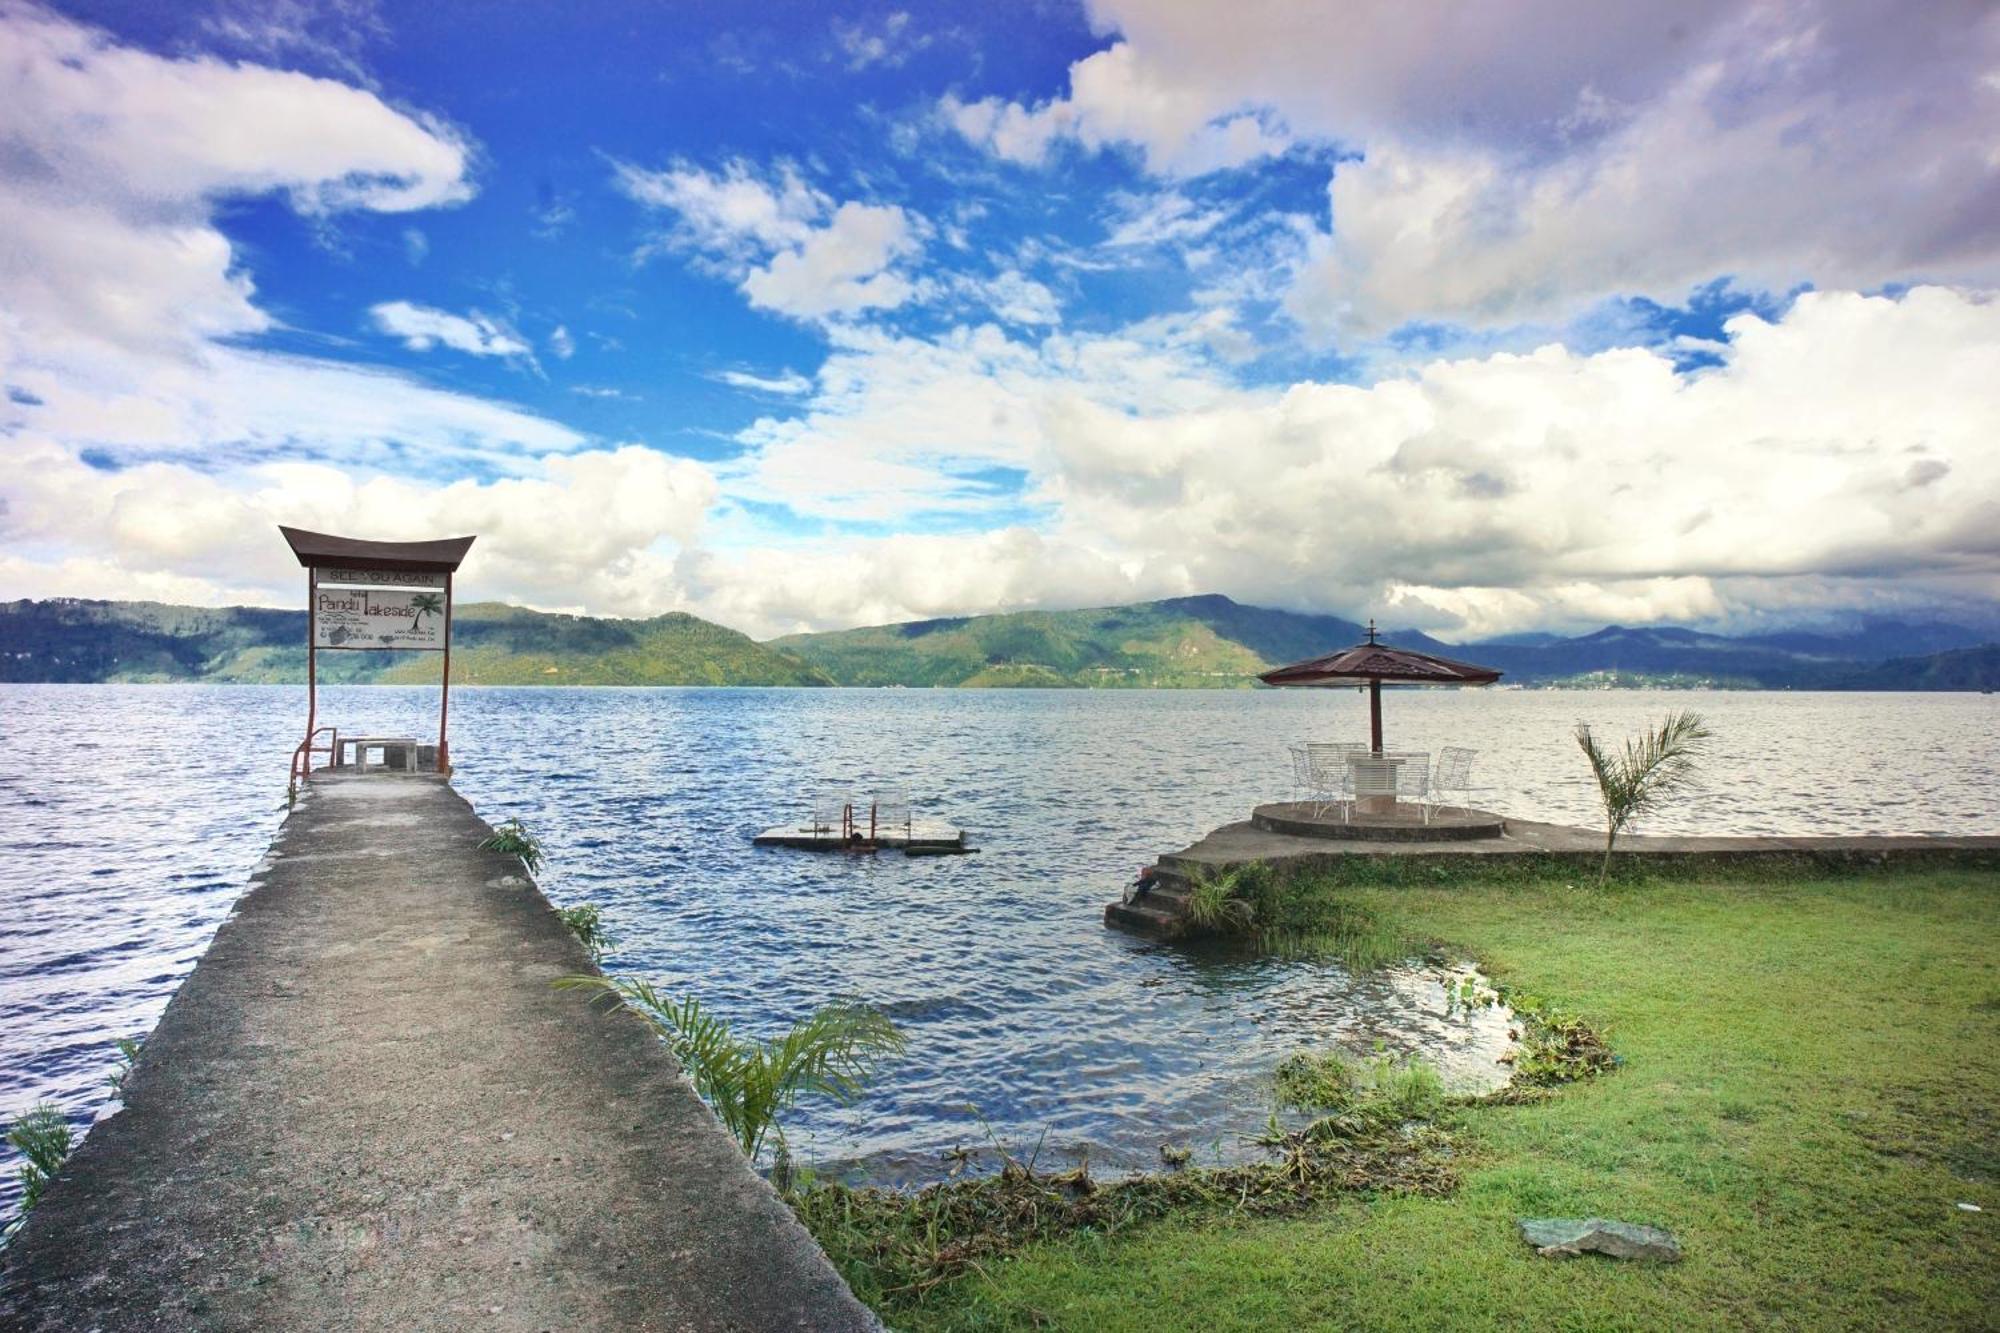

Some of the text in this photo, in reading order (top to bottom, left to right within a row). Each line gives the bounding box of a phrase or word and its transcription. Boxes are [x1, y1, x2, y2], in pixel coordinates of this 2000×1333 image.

[330, 570, 434, 584] SEE YOU AGAIN
[319, 594, 359, 611] Pandu
